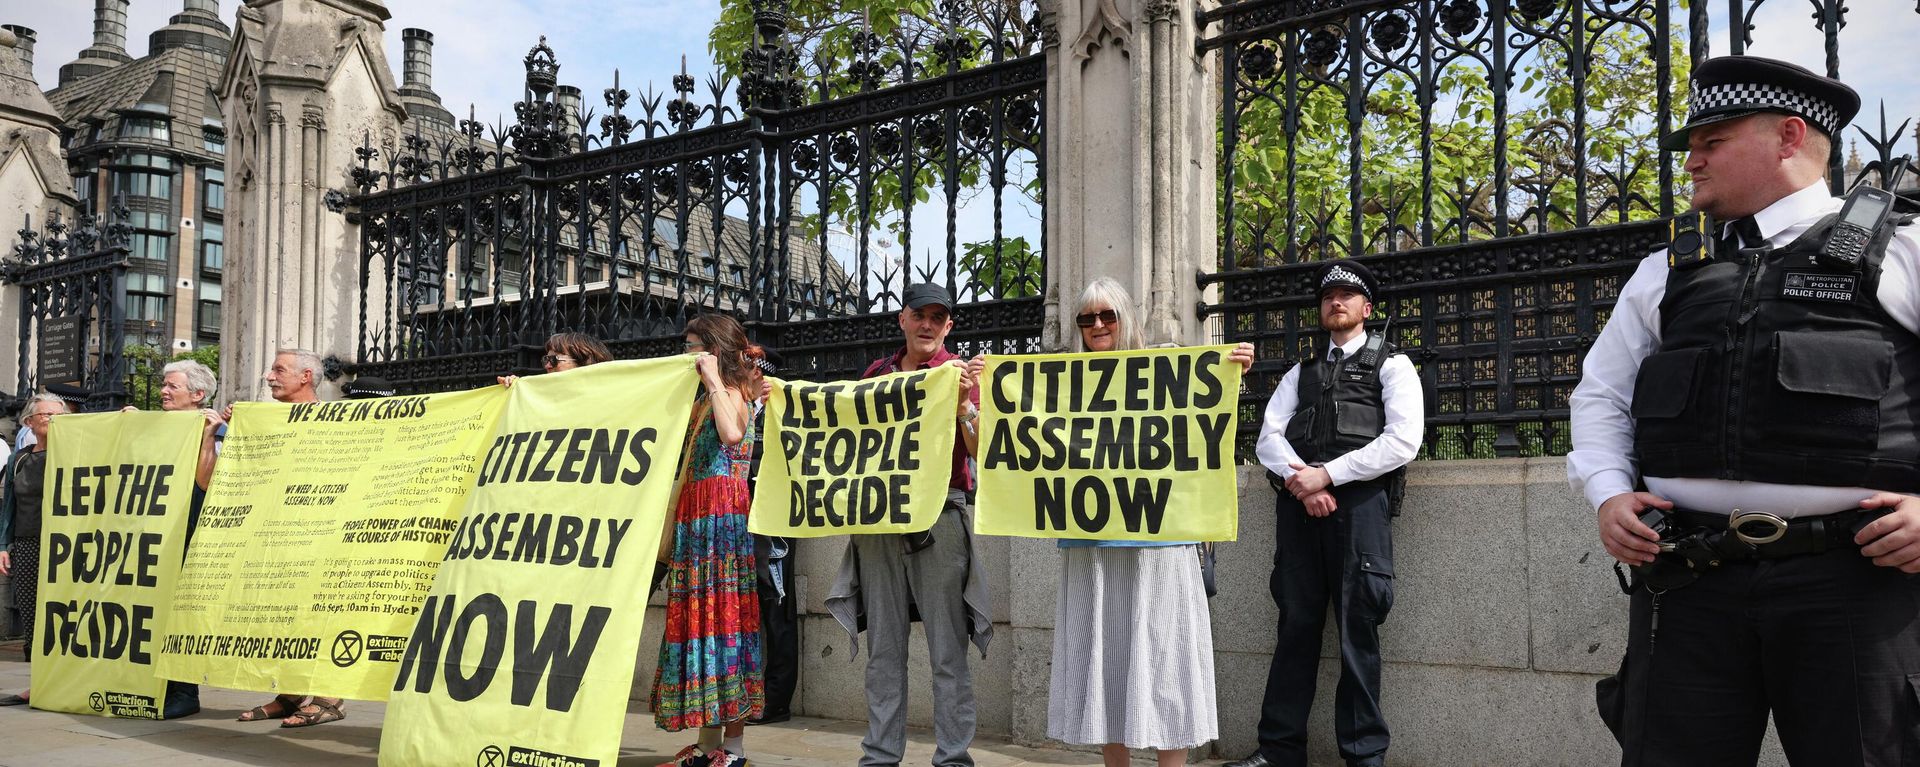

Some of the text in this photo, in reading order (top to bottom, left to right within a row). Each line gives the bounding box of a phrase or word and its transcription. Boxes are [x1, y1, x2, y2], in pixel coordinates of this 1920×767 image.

[1783, 288, 1852, 300] POLICE OFFICER
[45, 322, 74, 332] Carriage Gates
[991, 350, 1223, 415] CITIZENS
[288, 397, 429, 423] WE ARE IN CRISIS
[781, 372, 927, 430] LET THE
[780, 422, 921, 477] PEOPLE
[984, 412, 1232, 473] ASSEMBLY
[477, 427, 658, 487] CITIZENS
[415, 476, 429, 484] the
[451, 473, 463, 482] be
[419, 465, 433, 475] get
[452, 463, 475, 474] with.
[52, 464, 174, 516] LET THE
[285, 483, 349, 494] WE NEED A CITIZENS
[445, 485, 467, 496] only
[317, 496, 337, 506] NOW
[788, 474, 912, 529] DECIDE
[1034, 474, 1173, 535] NOW
[342, 516, 458, 532] PEOPLE POWER CAN CHANG
[342, 530, 451, 544] THE COURSE OF HISTORY
[443, 512, 633, 569] ASSEMBLY
[47, 529, 162, 588] PEOPLE
[329, 568, 352, 579] people
[360, 568, 392, 579] upgrade
[393, 569, 429, 580] politics
[338, 580, 366, 588] Citizens
[366, 580, 412, 591] Assembly.
[313, 592, 328, 602] why
[346, 591, 370, 603] asking
[372, 590, 387, 600] for
[387, 595, 409, 603] your
[311, 602, 326, 612] 10th
[326, 602, 345, 614] Sept,
[346, 602, 369, 612] 10am
[370, 603, 380, 612] in
[382, 604, 409, 615] Hyde
[43, 599, 154, 665] DECIDE
[165, 634, 184, 654] TIME
[184, 635, 195, 655] TO
[196, 635, 214, 655] LET
[213, 636, 233, 656] THE
[232, 636, 272, 658] PEOPLE
[272, 638, 321, 659] DECIDE!
[369, 637, 407, 648] extincti
[393, 592, 612, 713] NOW
